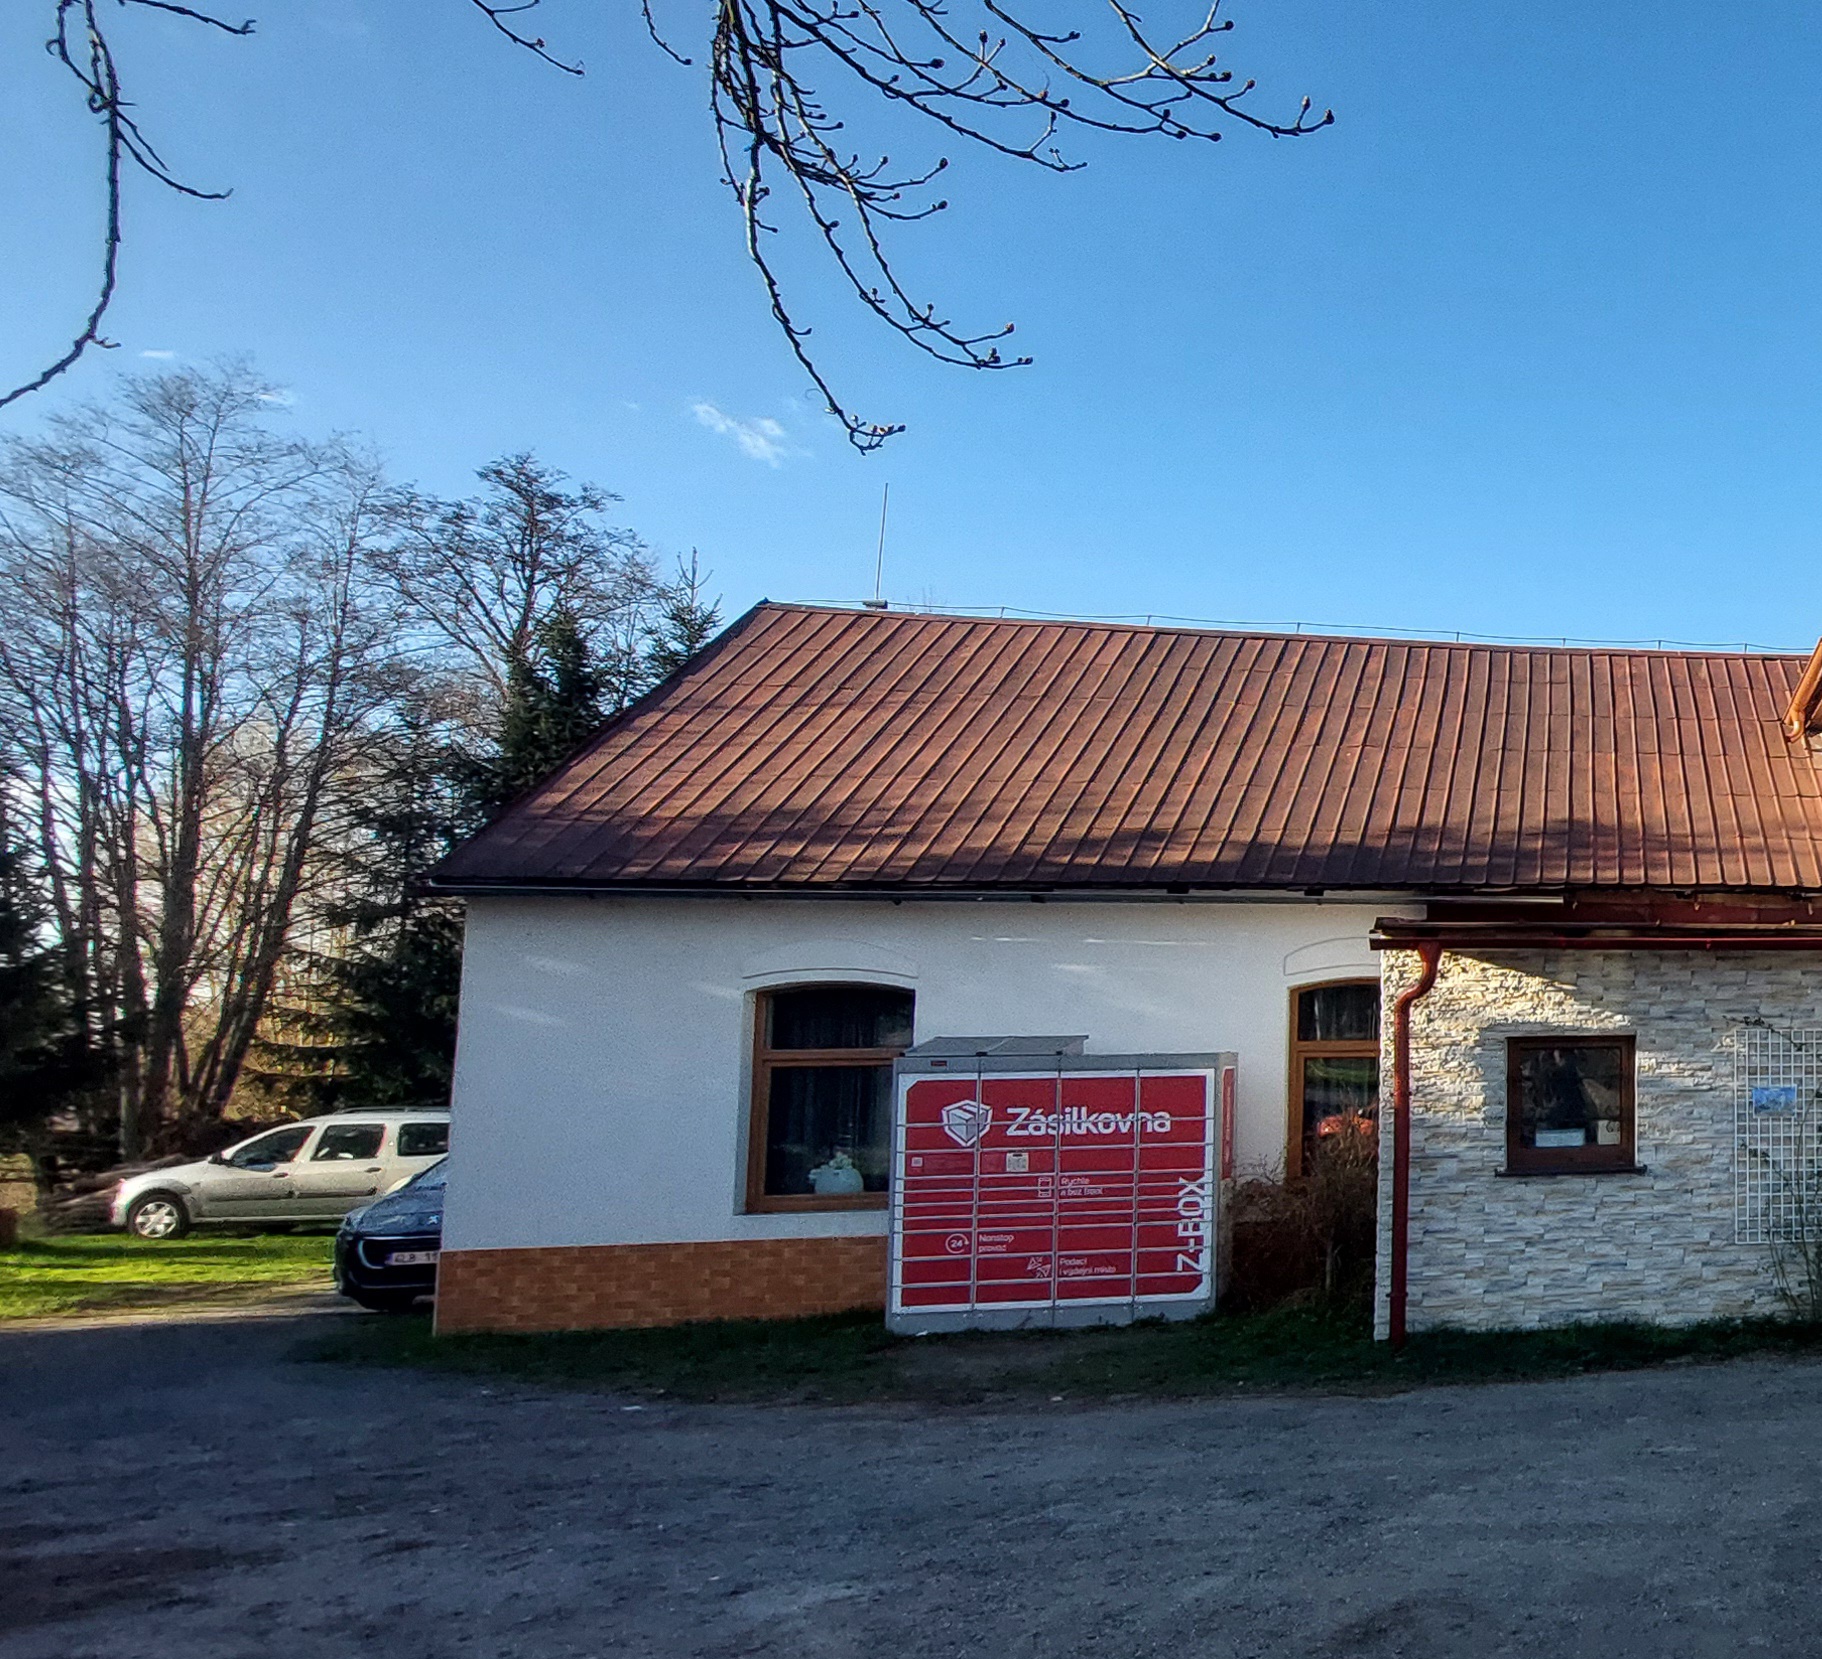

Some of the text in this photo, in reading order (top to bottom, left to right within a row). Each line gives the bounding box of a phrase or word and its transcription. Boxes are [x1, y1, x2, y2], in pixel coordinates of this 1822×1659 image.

[1006, 1106, 1171, 1137] Zásilkovna
[1176, 1177, 1205, 1271] Z-BOX
[950, 1238, 963, 1248] 24
[979, 1234, 1014, 1243] Nonstop
